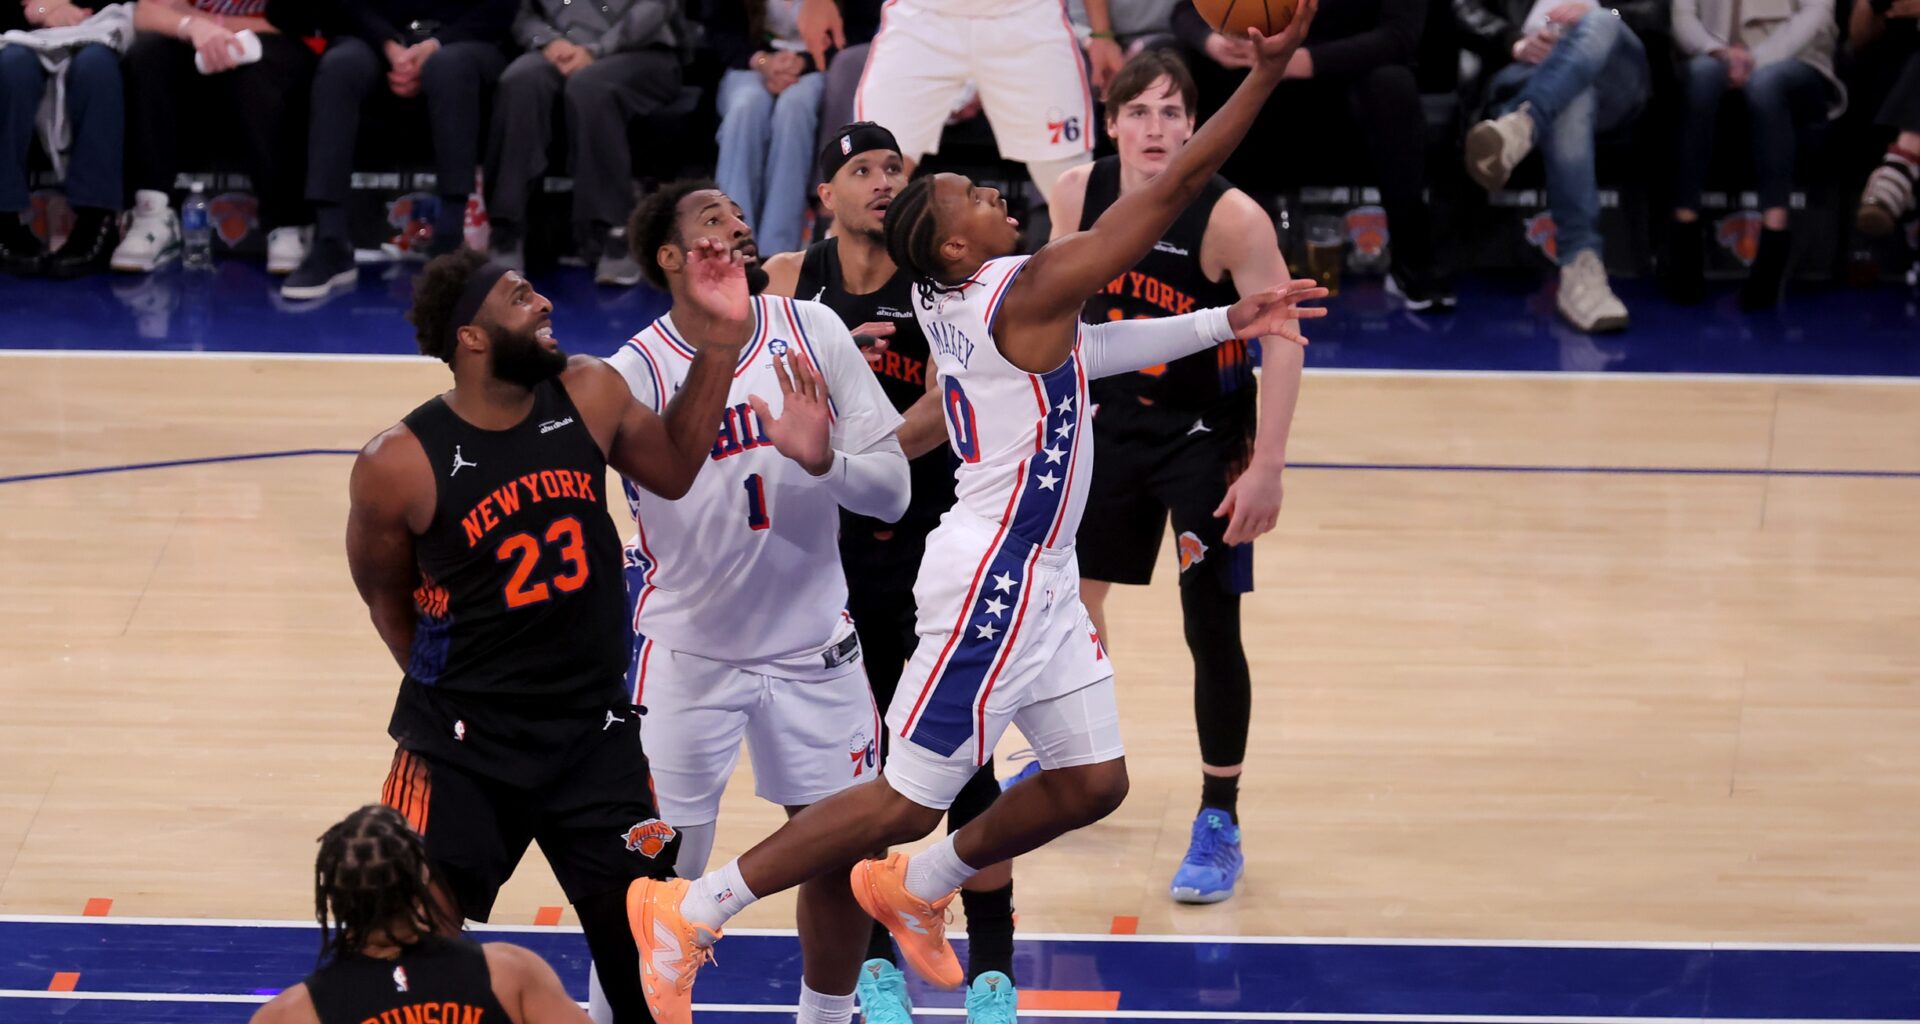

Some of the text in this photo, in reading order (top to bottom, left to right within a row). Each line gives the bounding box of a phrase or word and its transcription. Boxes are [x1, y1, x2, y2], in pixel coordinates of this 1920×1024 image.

[1047, 116, 1080, 145] 76
[1129, 271, 1195, 315] YORK
[927, 321, 975, 370] MAXEY
[945, 375, 981, 464] 0
[461, 469, 597, 547] NEW YORK
[744, 473, 770, 531] 1
[496, 516, 590, 609] 23
[849, 738, 875, 777] 76
[361, 1002, 485, 1024] UNSON
